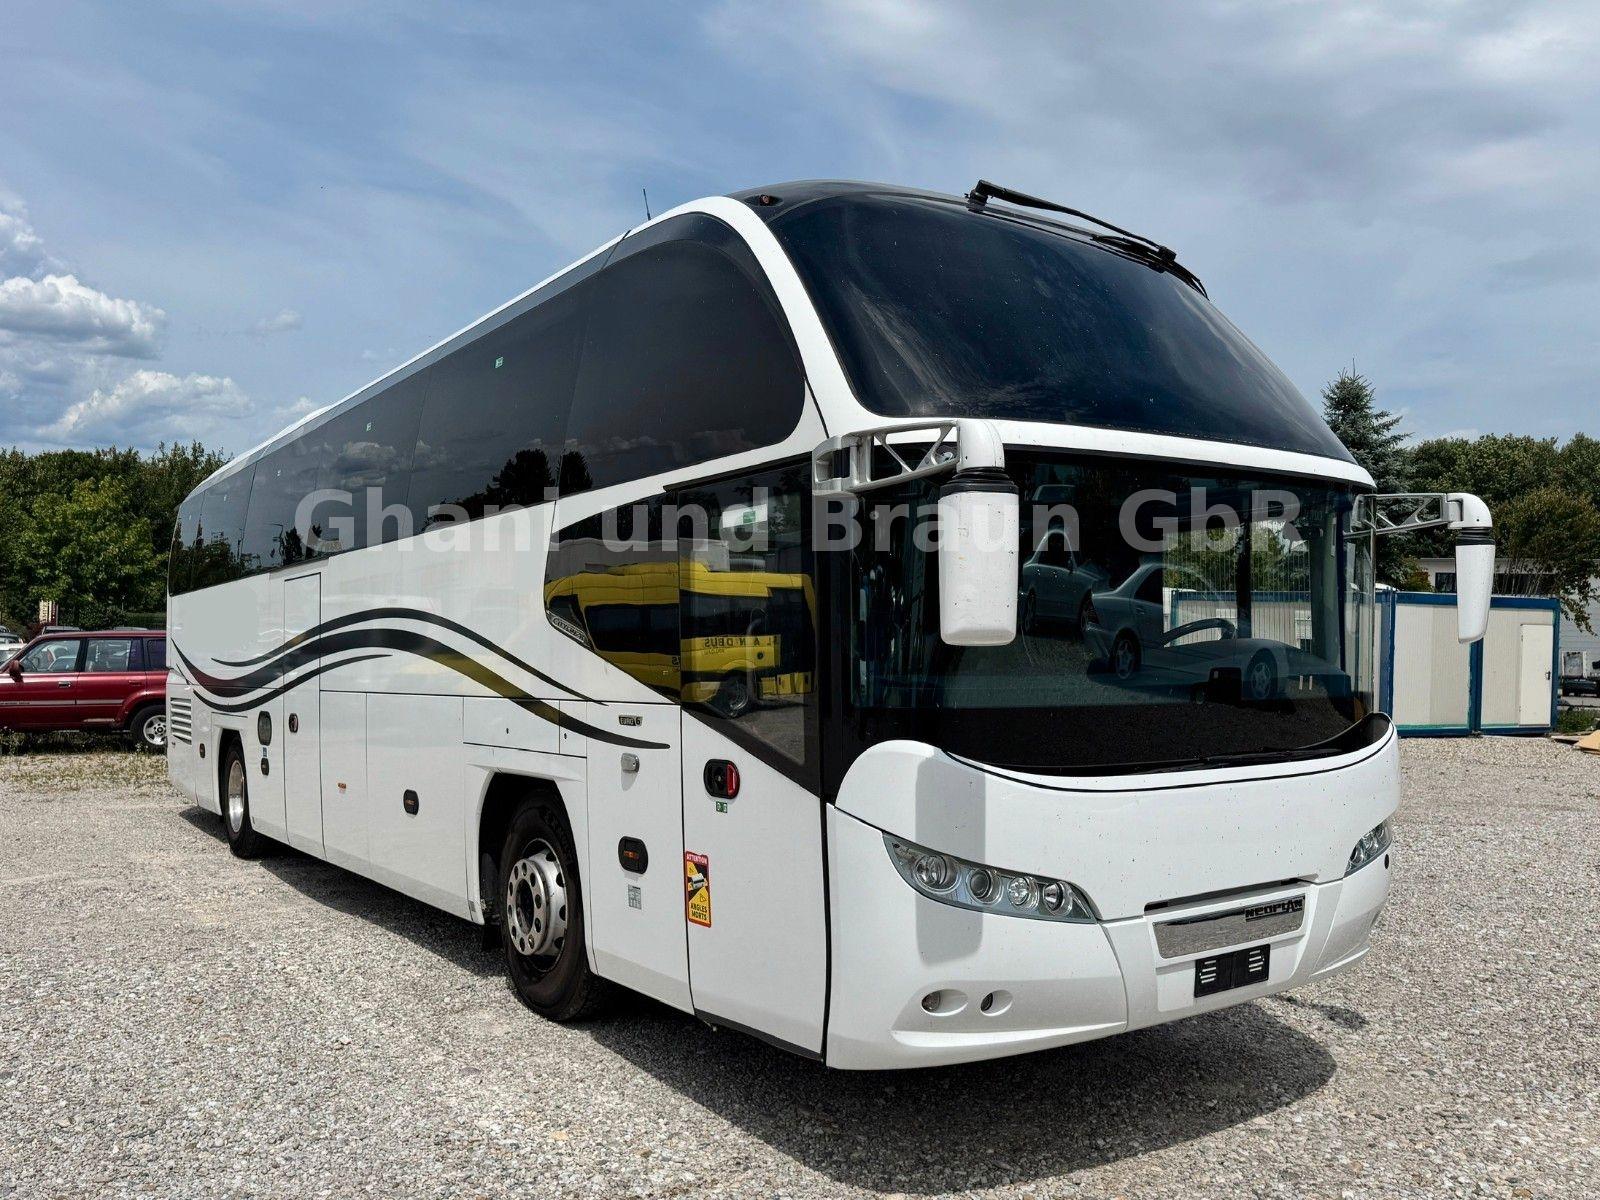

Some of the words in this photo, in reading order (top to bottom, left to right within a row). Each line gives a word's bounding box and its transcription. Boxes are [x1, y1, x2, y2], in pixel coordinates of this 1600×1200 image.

[686, 853, 708, 865] ATTENTION
[690, 902, 708, 913] ANGLES
[1245, 898, 1303, 918] NEOPLAN
[691, 910, 707, 921] MORTS
